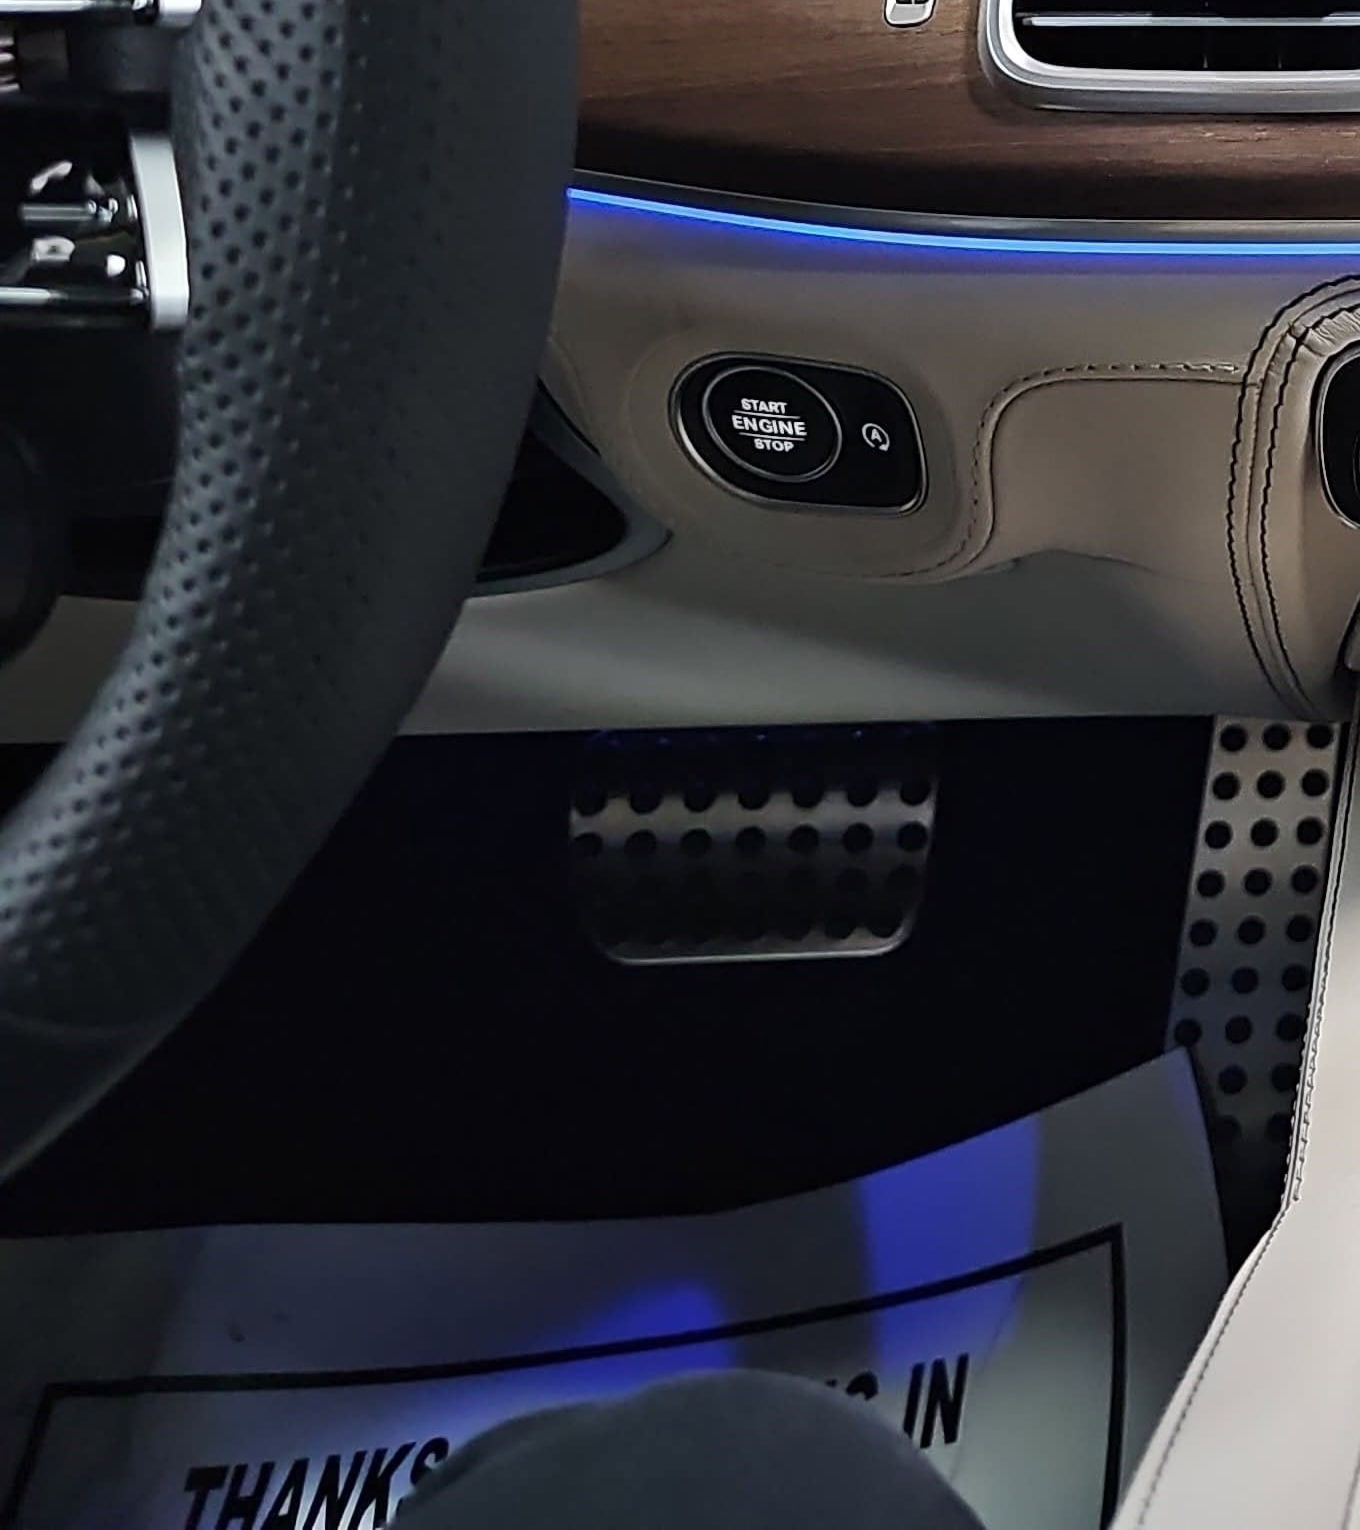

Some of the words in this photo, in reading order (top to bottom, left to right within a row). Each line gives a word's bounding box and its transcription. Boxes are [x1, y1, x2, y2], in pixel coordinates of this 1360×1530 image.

[740, 398, 788, 415] START
[731, 415, 807, 436] ENGINE
[754, 438, 794, 452] STOP
